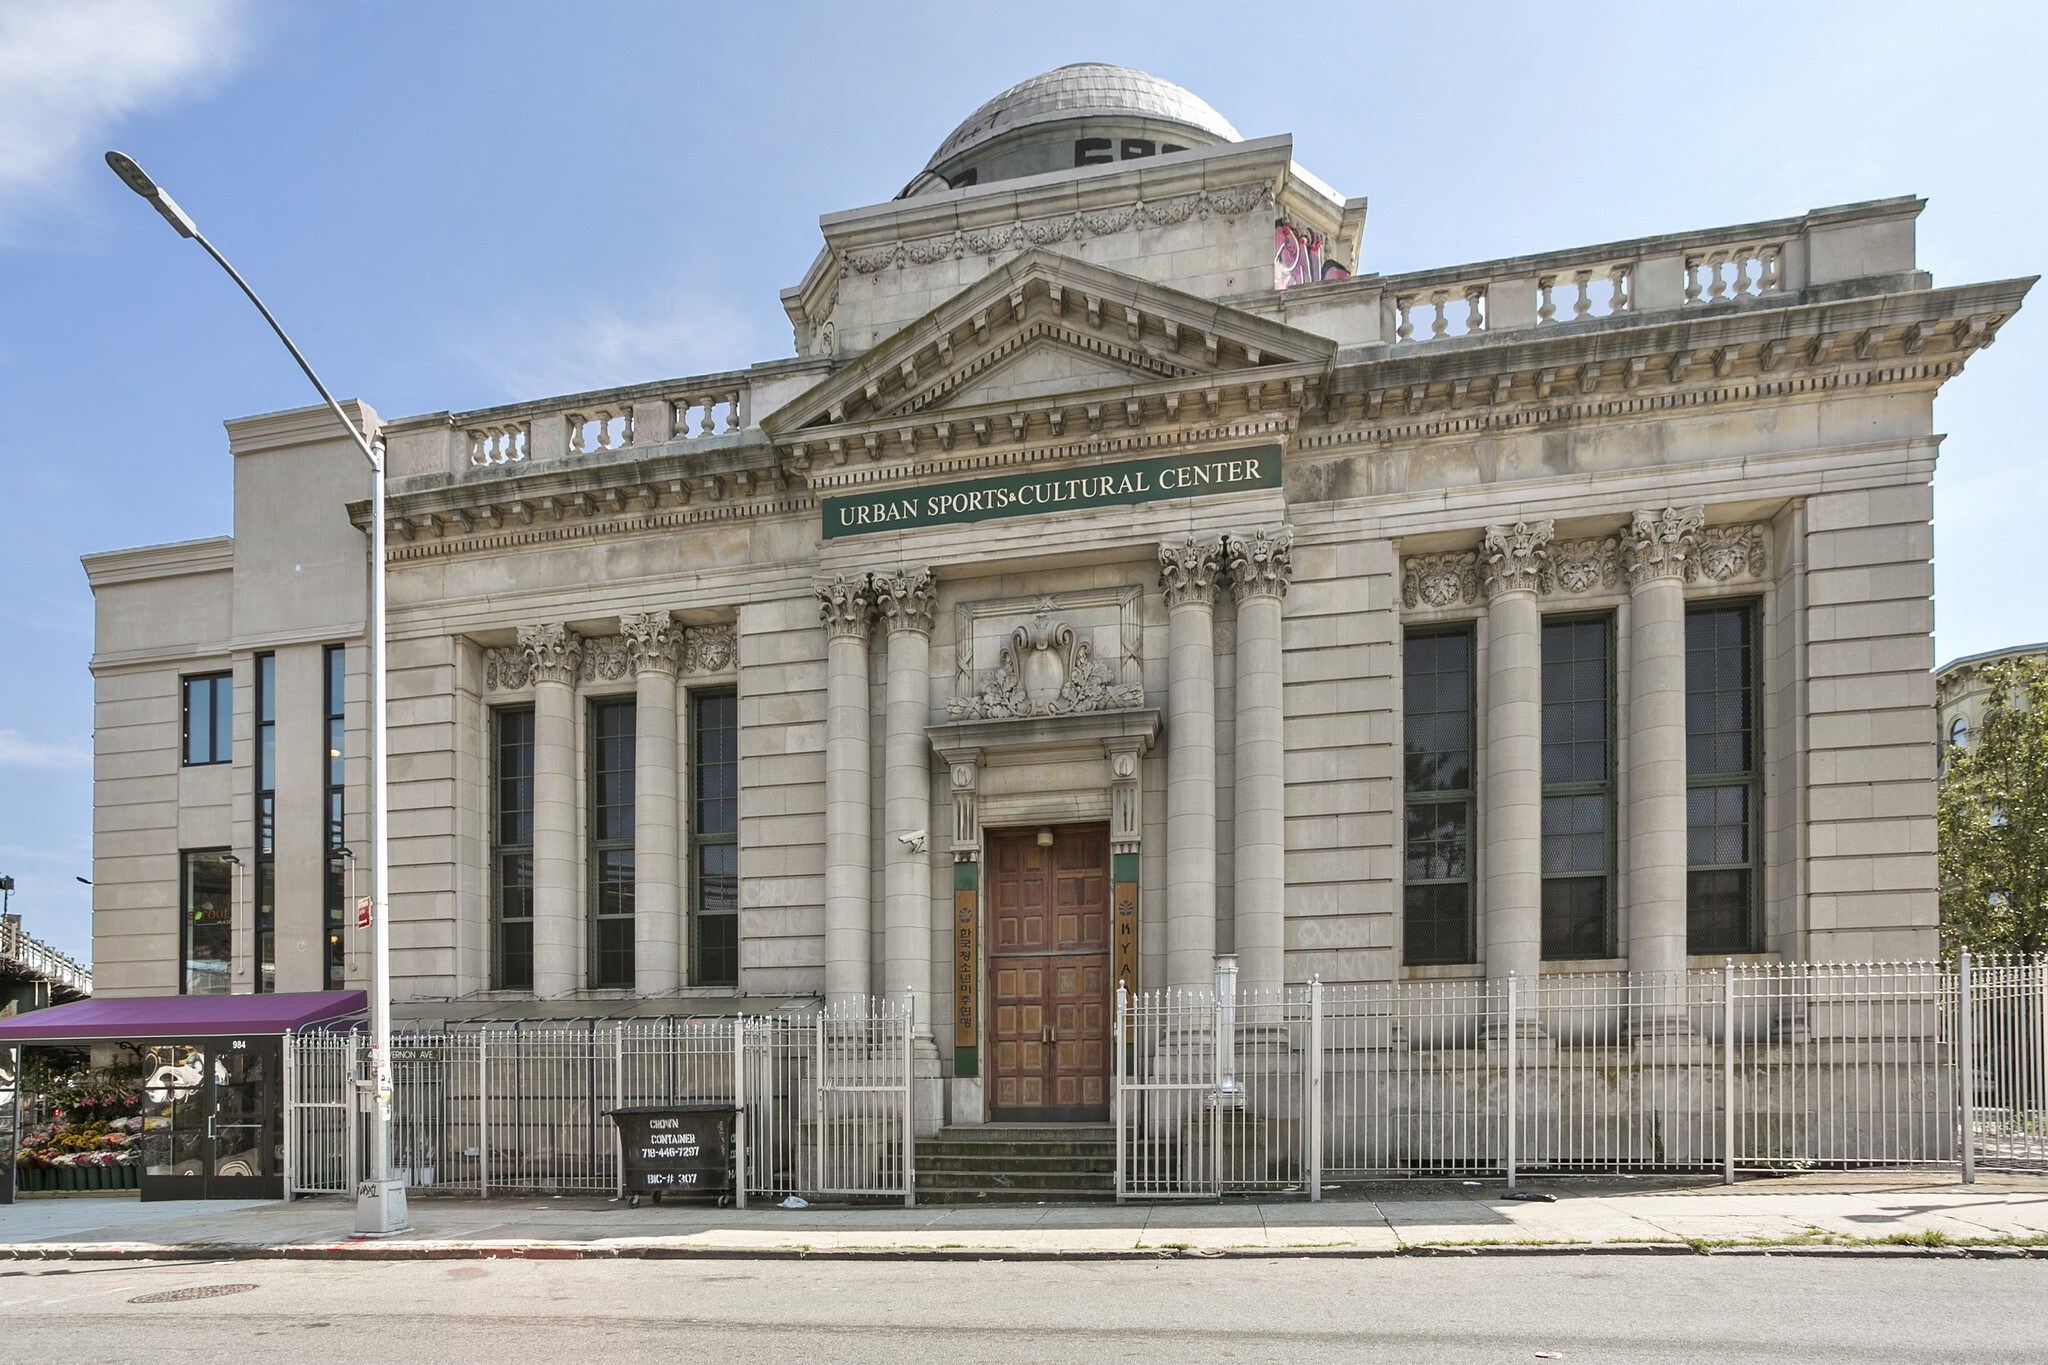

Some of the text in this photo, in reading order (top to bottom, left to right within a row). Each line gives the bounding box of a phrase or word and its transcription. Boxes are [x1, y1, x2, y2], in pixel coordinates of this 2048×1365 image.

[840, 499, 918, 526] URBAN
[1159, 459, 1262, 490] CENTER
[232, 1040, 246, 1049] 984
[389, 1050, 416, 1059] ERNON
[650, 1118, 679, 1129] CROWN
[651, 1133, 696, 1145] CONTAINER
[641, 1146, 700, 1158] 718-446-7297
[678, 1173, 697, 1184] 307
